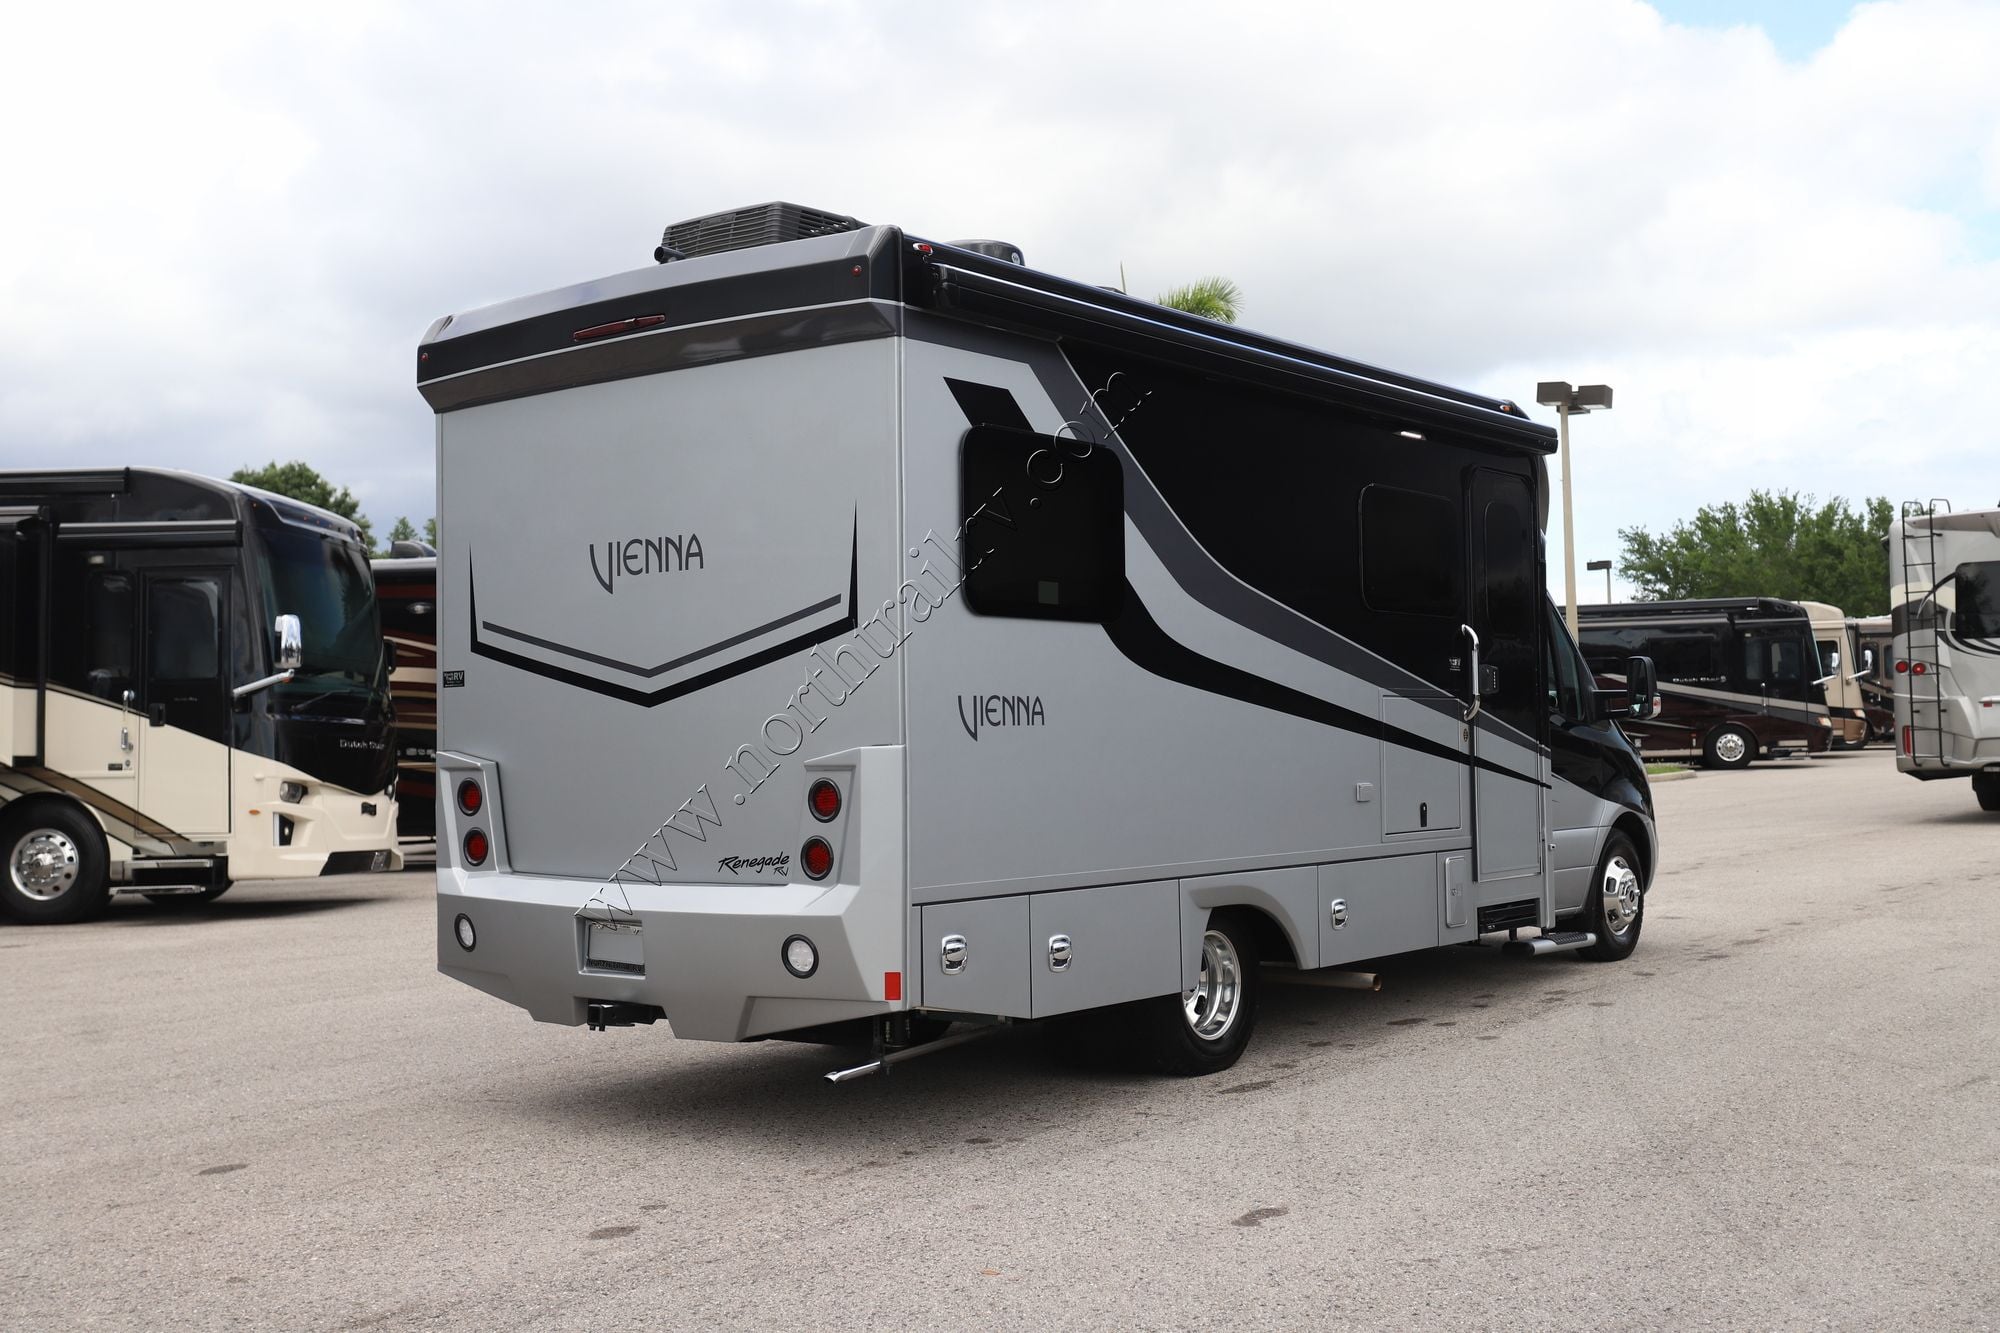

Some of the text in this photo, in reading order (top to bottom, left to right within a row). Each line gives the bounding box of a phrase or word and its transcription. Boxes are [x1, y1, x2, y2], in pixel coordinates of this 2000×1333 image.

[589, 533, 704, 595] VIENNA
[957, 694, 1045, 742] VIENNA
[717, 850, 790, 875] Renegade
[773, 866, 789, 877] RV
